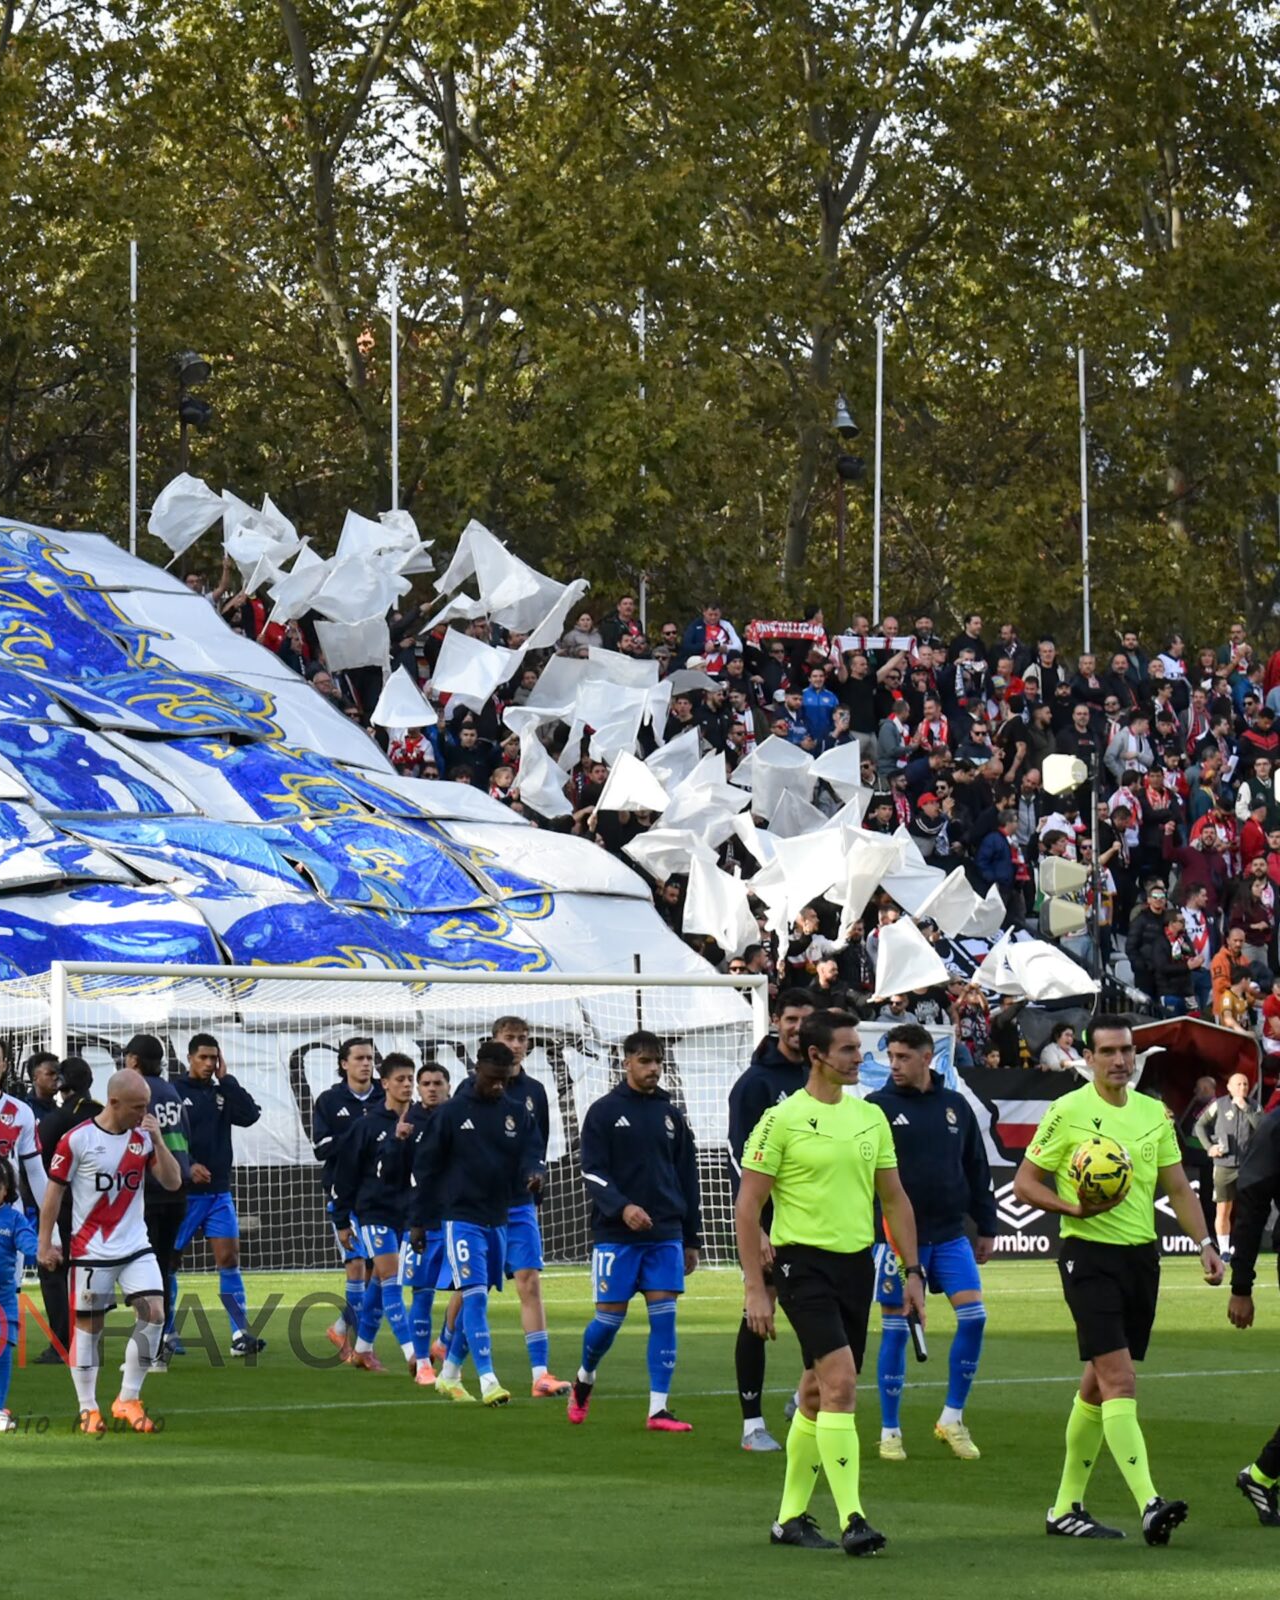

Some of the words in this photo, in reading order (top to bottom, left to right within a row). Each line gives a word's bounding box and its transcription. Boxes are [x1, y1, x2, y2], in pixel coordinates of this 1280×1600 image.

[95, 1170, 140, 1192] DIG
[456, 1240, 470, 1262] 6
[598, 1252, 616, 1277] 17
[884, 1250, 898, 1275] 8
[84, 1268, 94, 1290] 7
